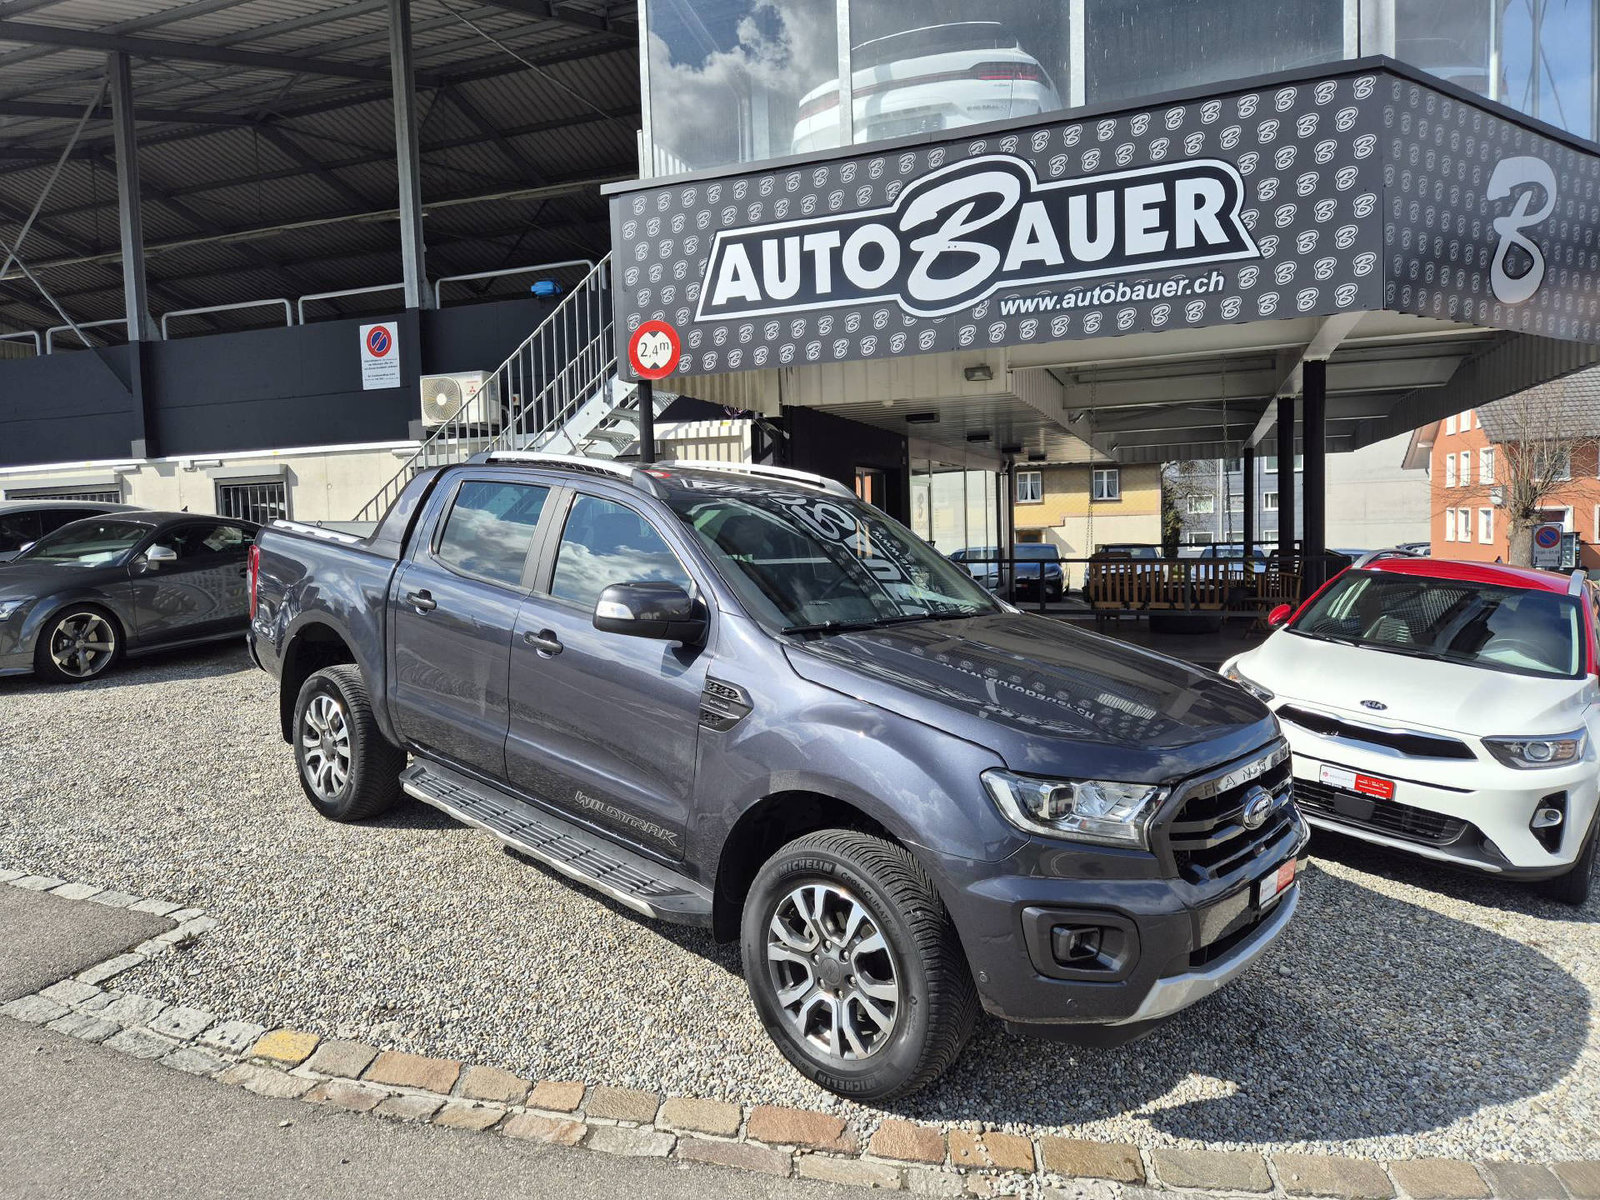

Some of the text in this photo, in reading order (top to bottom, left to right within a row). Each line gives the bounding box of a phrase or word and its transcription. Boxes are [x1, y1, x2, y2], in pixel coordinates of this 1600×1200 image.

[1000, 271, 1224, 316] www.autobauer.ch
[779, 859, 833, 875] MICHELIN
[817, 1072, 878, 1091] MICHELIN
